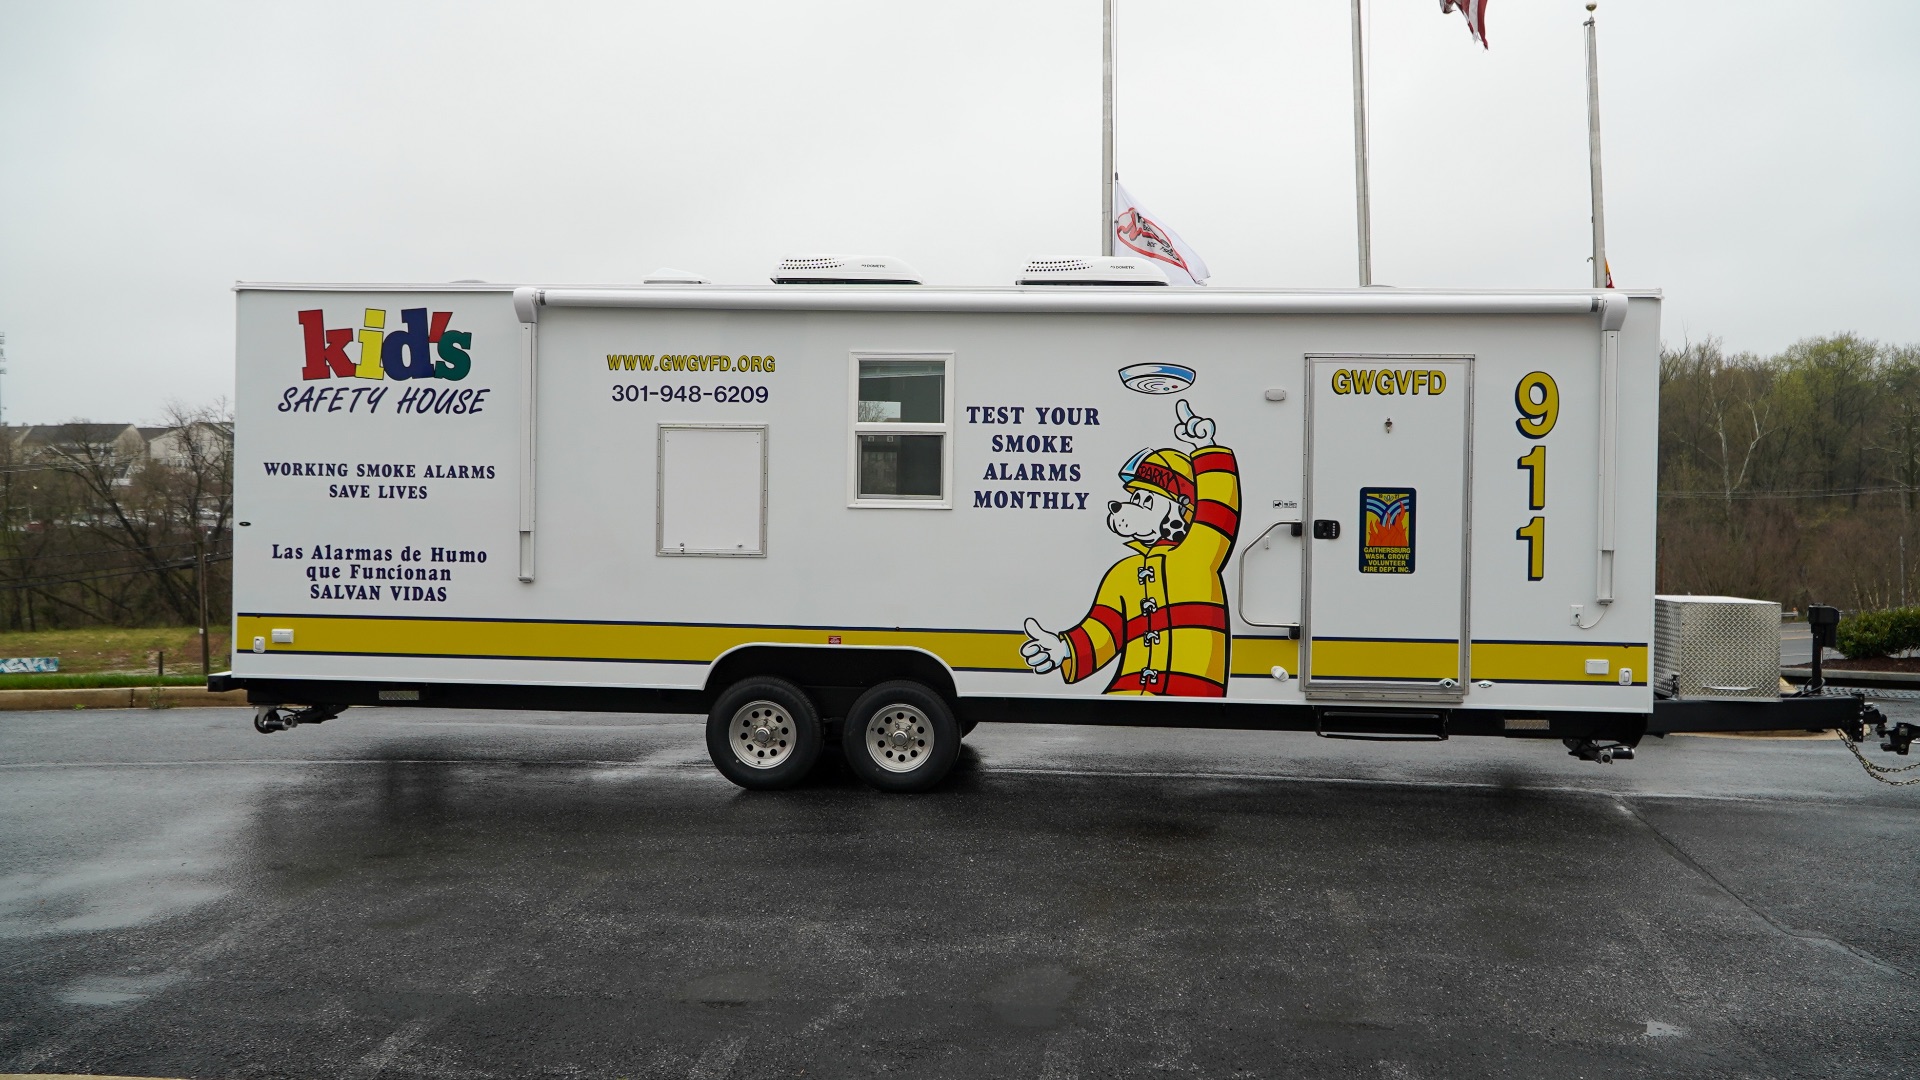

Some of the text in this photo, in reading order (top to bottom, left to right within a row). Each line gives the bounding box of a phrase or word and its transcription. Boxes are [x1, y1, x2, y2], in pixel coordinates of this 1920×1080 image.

[298, 308, 472, 381] kid's
[607, 354, 775, 372] WWW.GWGVFD.ORG
[1332, 369, 1446, 395] GWGVFD
[278, 386, 490, 414] SAFETY HOUSE
[612, 385, 768, 403] 301-948-6209
[966, 406, 1100, 425] TEST YOUR
[992, 435, 1073, 453] SMOKE
[264, 463, 495, 479] WORKING SMOKE ALARMS
[983, 463, 1081, 482] ALARMS
[330, 485, 427, 499] SAVE LIVES
[973, 491, 1089, 510] MONTHLY
[272, 544, 487, 563] Las Alarmas de Humo
[307, 566, 340, 581] que
[311, 584, 446, 602] SALVAN VIDAS
